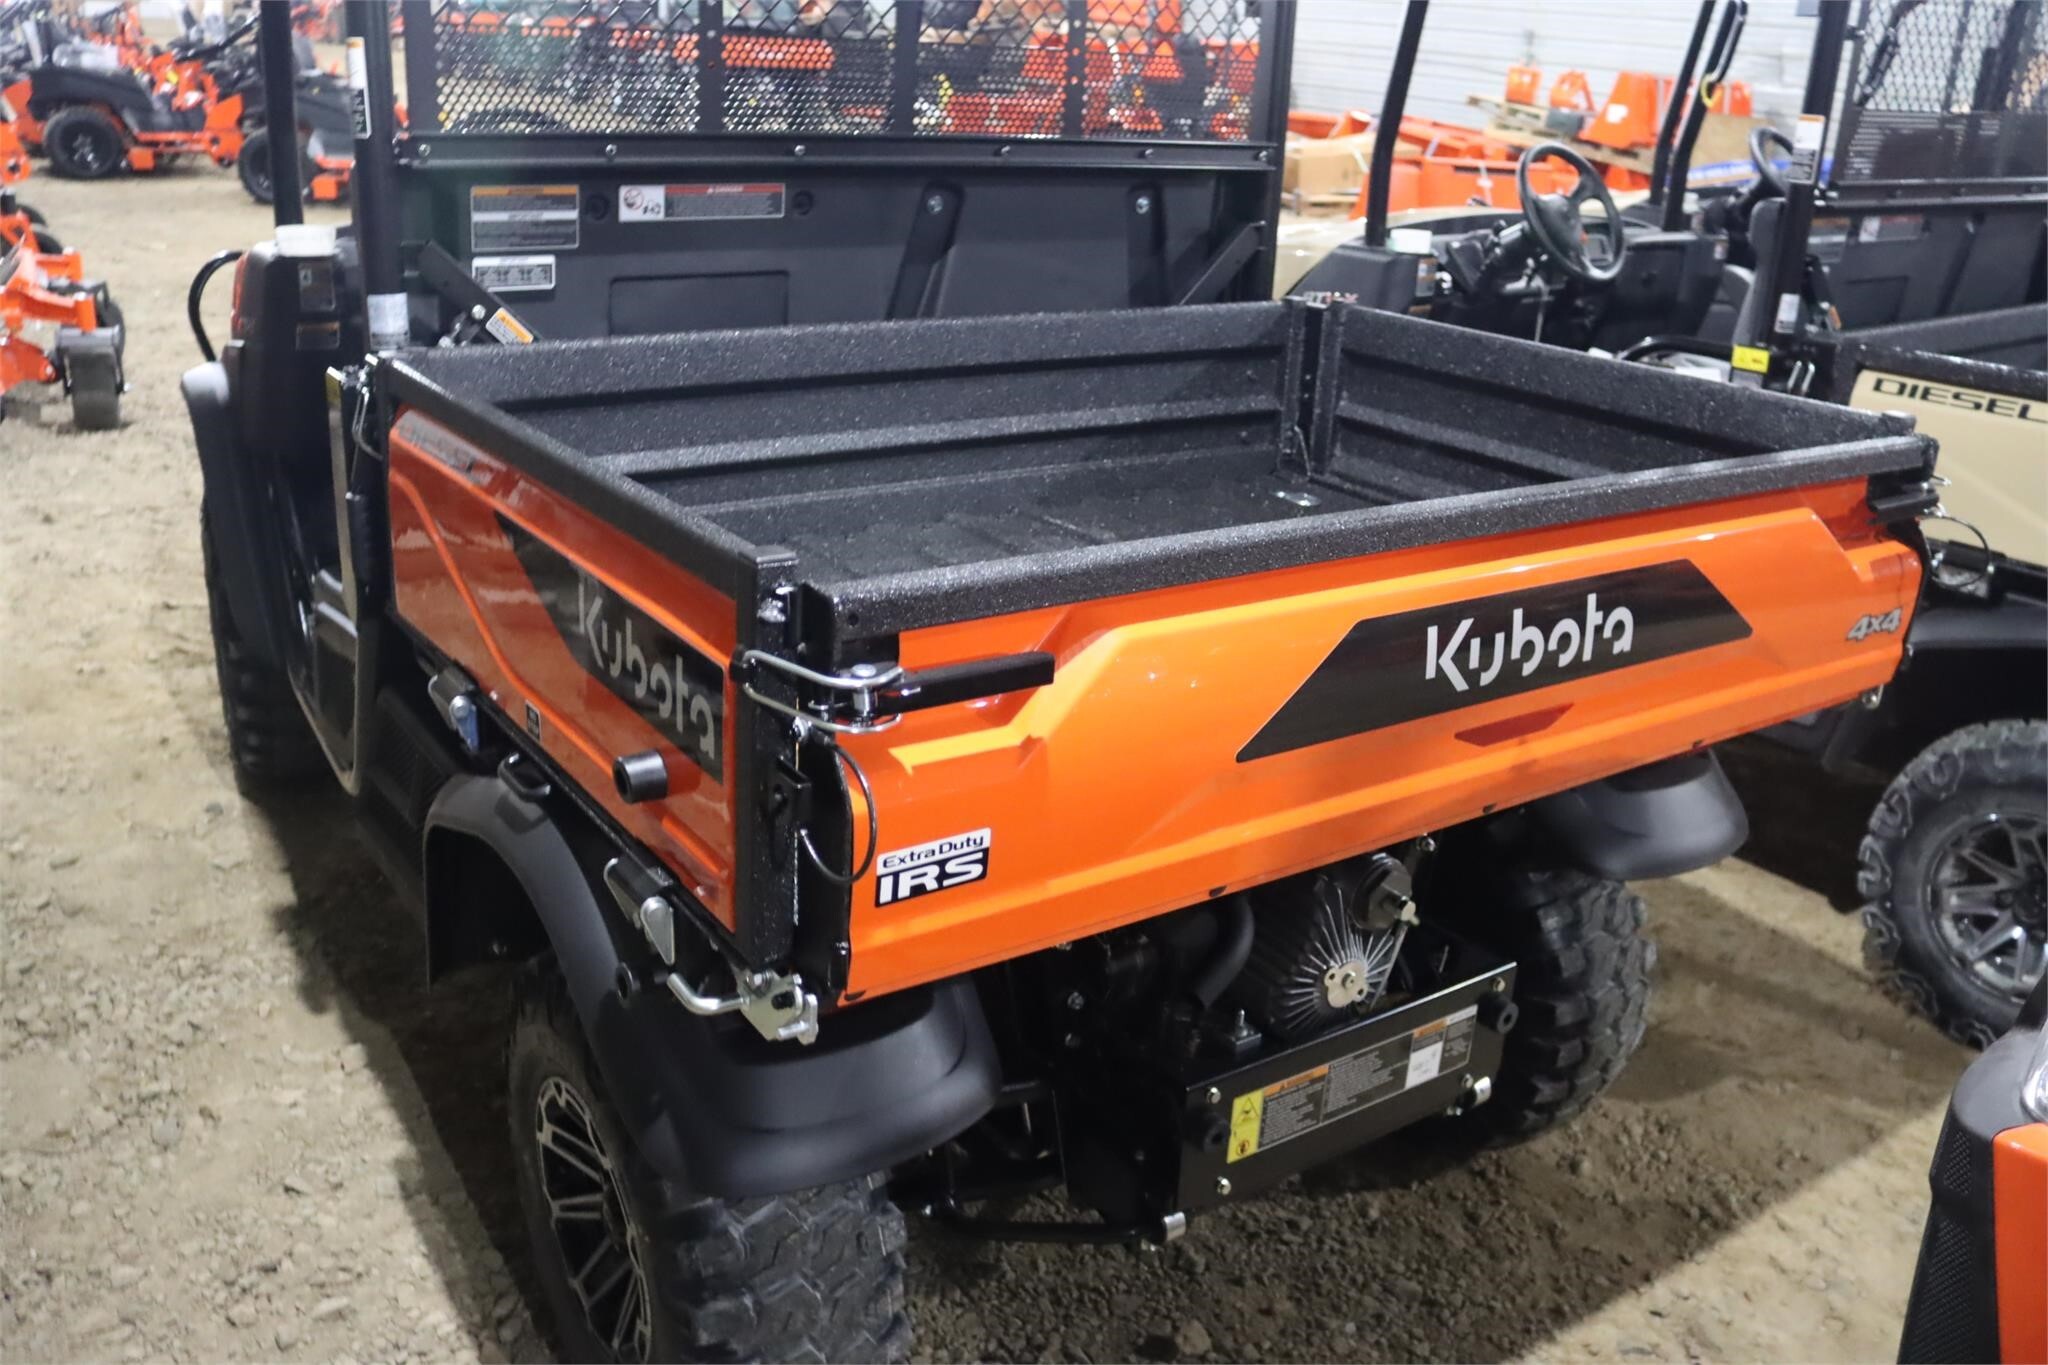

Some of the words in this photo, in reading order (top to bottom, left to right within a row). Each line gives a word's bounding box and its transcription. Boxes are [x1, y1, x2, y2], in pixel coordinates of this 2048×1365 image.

[1873, 377, 2047, 424] DIESEL
[1425, 592, 1635, 692] Kubota
[1846, 607, 1902, 641] 4x4
[578, 571, 716, 760] Kubota
[883, 848, 936, 869] Extra
[939, 835, 984, 854] Duty
[879, 851, 984, 905] IRS
